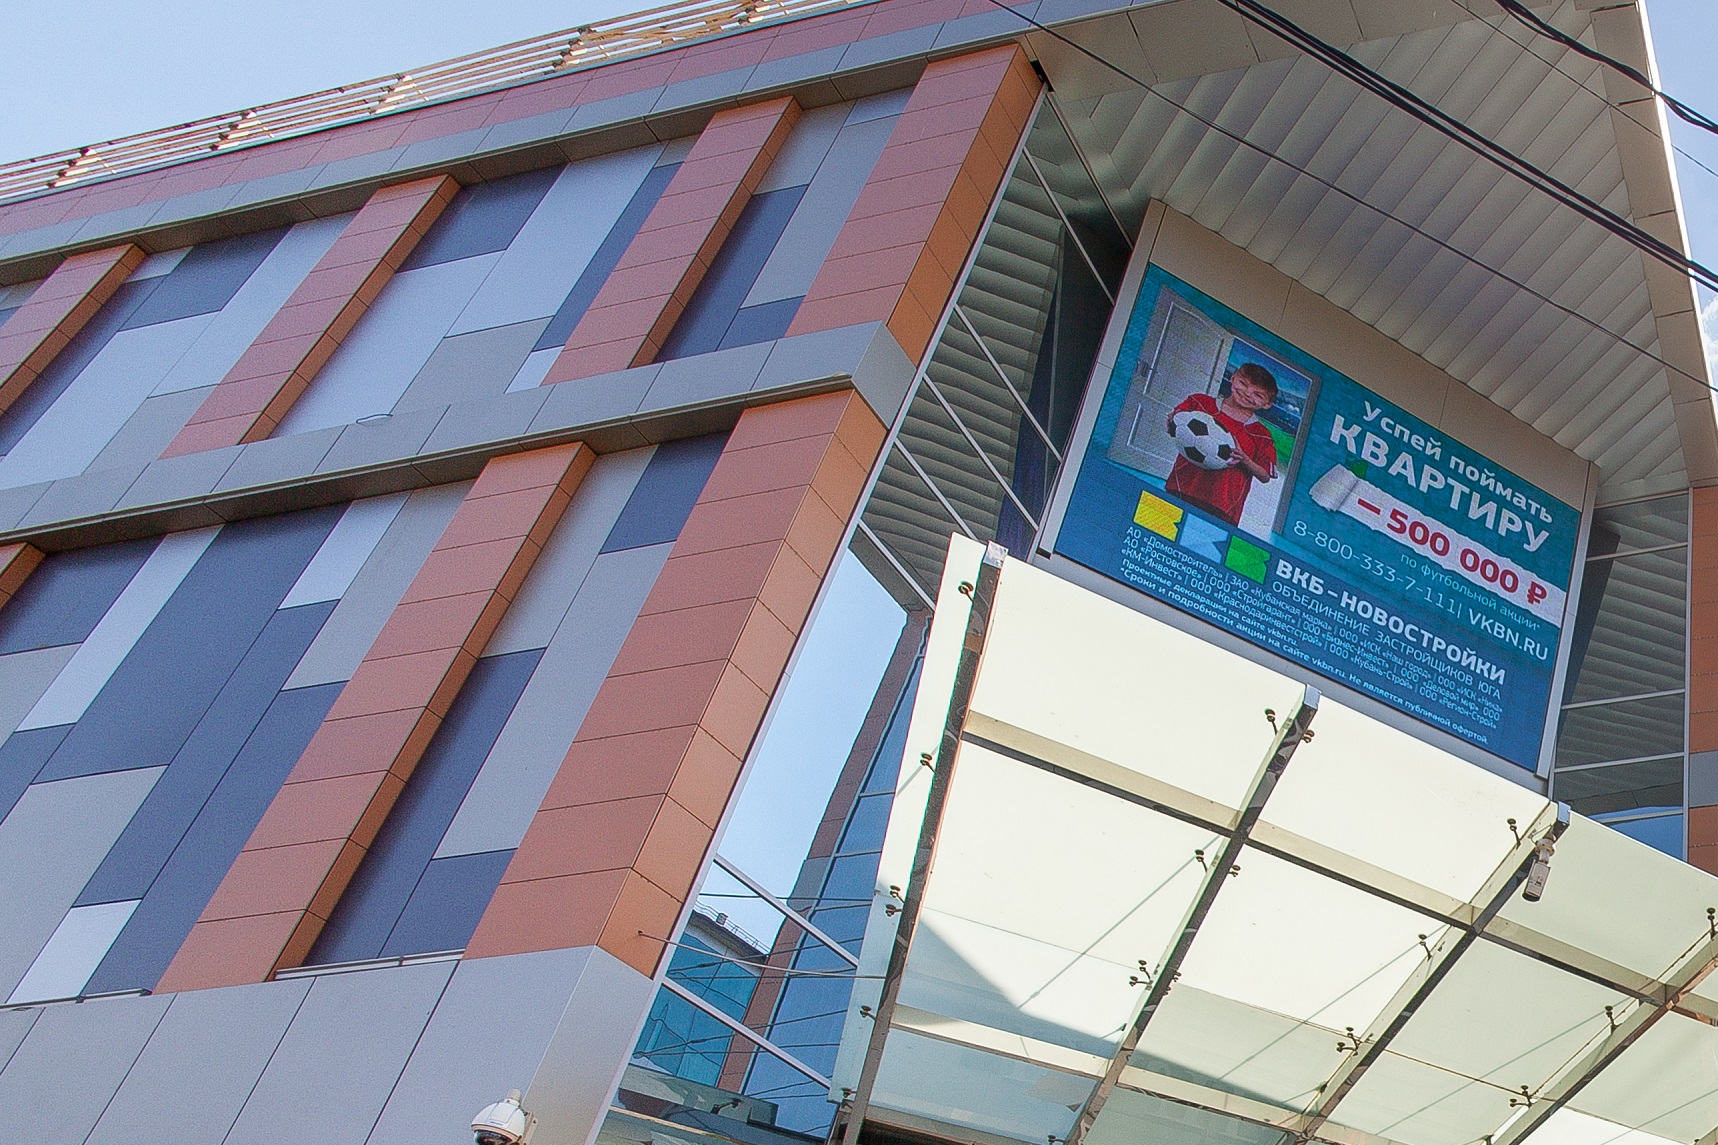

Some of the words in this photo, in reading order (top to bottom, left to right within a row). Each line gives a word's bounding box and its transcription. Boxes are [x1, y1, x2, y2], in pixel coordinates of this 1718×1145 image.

[1329, 413, 1550, 552] КВАРТИРУ
[1362, 400, 1442, 460] Успей
[1449, 455, 1553, 524] поймать
[1387, 507, 1450, 556] 500
[1460, 548, 1519, 593] 000
[1400, 553, 1417, 569] по
[1421, 562, 1497, 611] футбольной
[1168, 590, 1235, 626] подробности
[1236, 621, 1266, 642] акции
[1272, 581, 1371, 637] ОБЪЕДИНЕНИЕ
[1375, 630, 1473, 686] ЗАСТРОЙЩИКОВ
[1477, 680, 1501, 700] ЮГА
[1275, 559, 1325, 595] ВКБ
[1340, 590, 1506, 686] НОВОСТРОЙКИ
[1468, 608, 1549, 661] VKBN.RU
